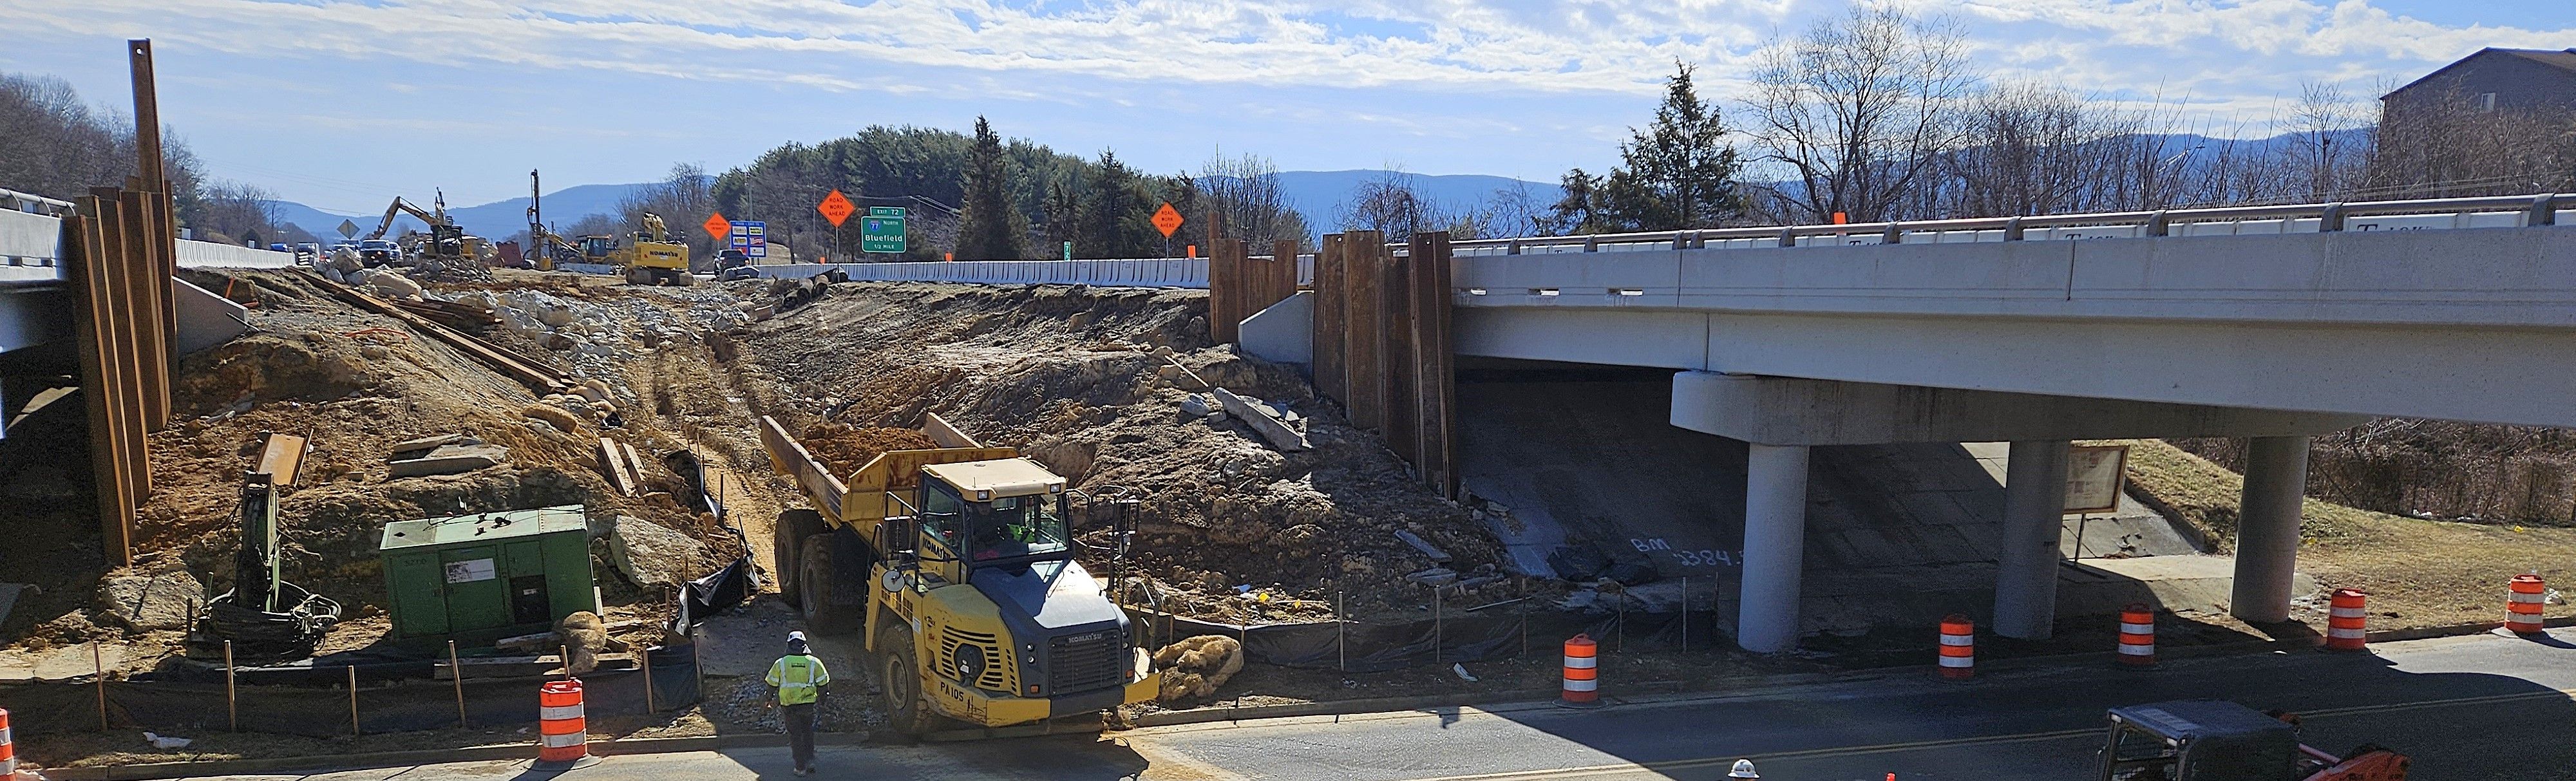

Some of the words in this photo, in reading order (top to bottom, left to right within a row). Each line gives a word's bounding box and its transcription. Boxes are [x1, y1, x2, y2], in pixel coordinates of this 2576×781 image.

[923, 537, 951, 563] KOMATSU
[1630, 538, 1671, 552] BM
[1068, 633, 1102, 643] KOMATSU
[940, 681, 964, 702] PA105
